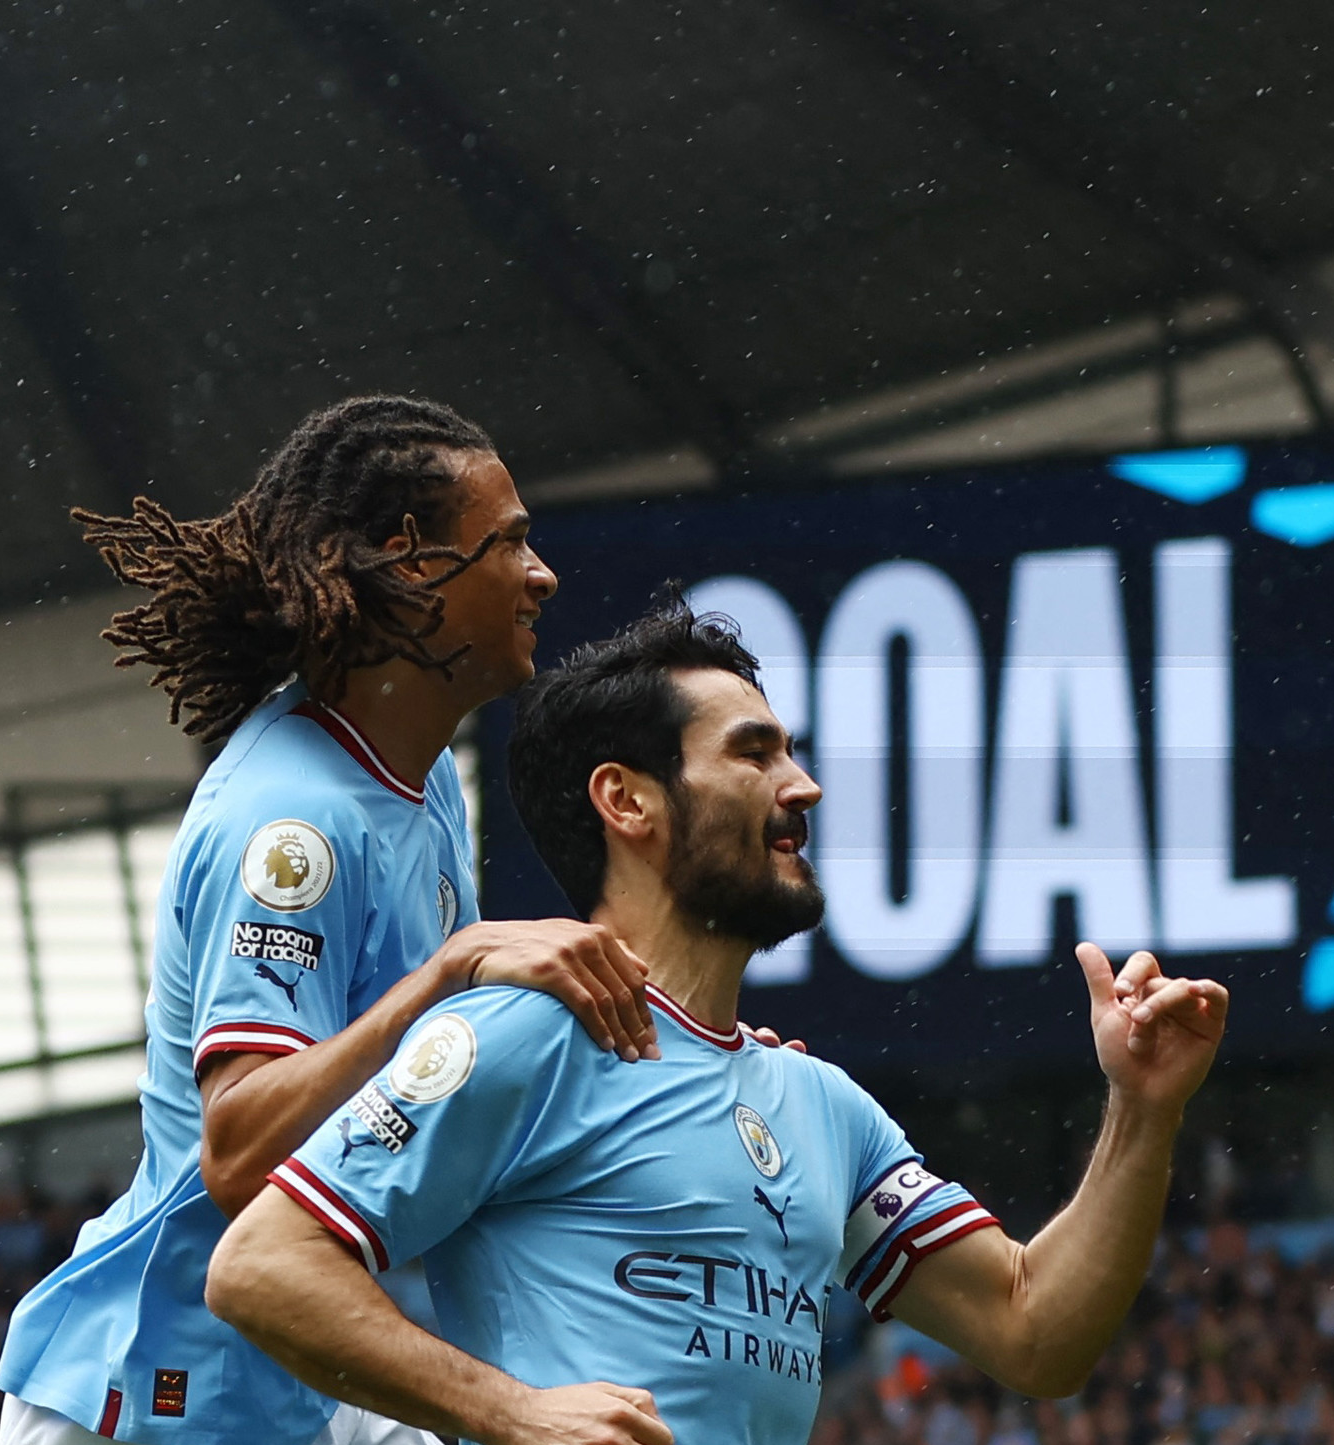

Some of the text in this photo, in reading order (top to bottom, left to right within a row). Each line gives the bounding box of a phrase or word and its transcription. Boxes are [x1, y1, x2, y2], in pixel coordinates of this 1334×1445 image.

[230, 940, 318, 971] for racism
[234, 922, 314, 953] No room
[369, 1095, 408, 1136] room
[615, 1250, 833, 1334] ETIHA
